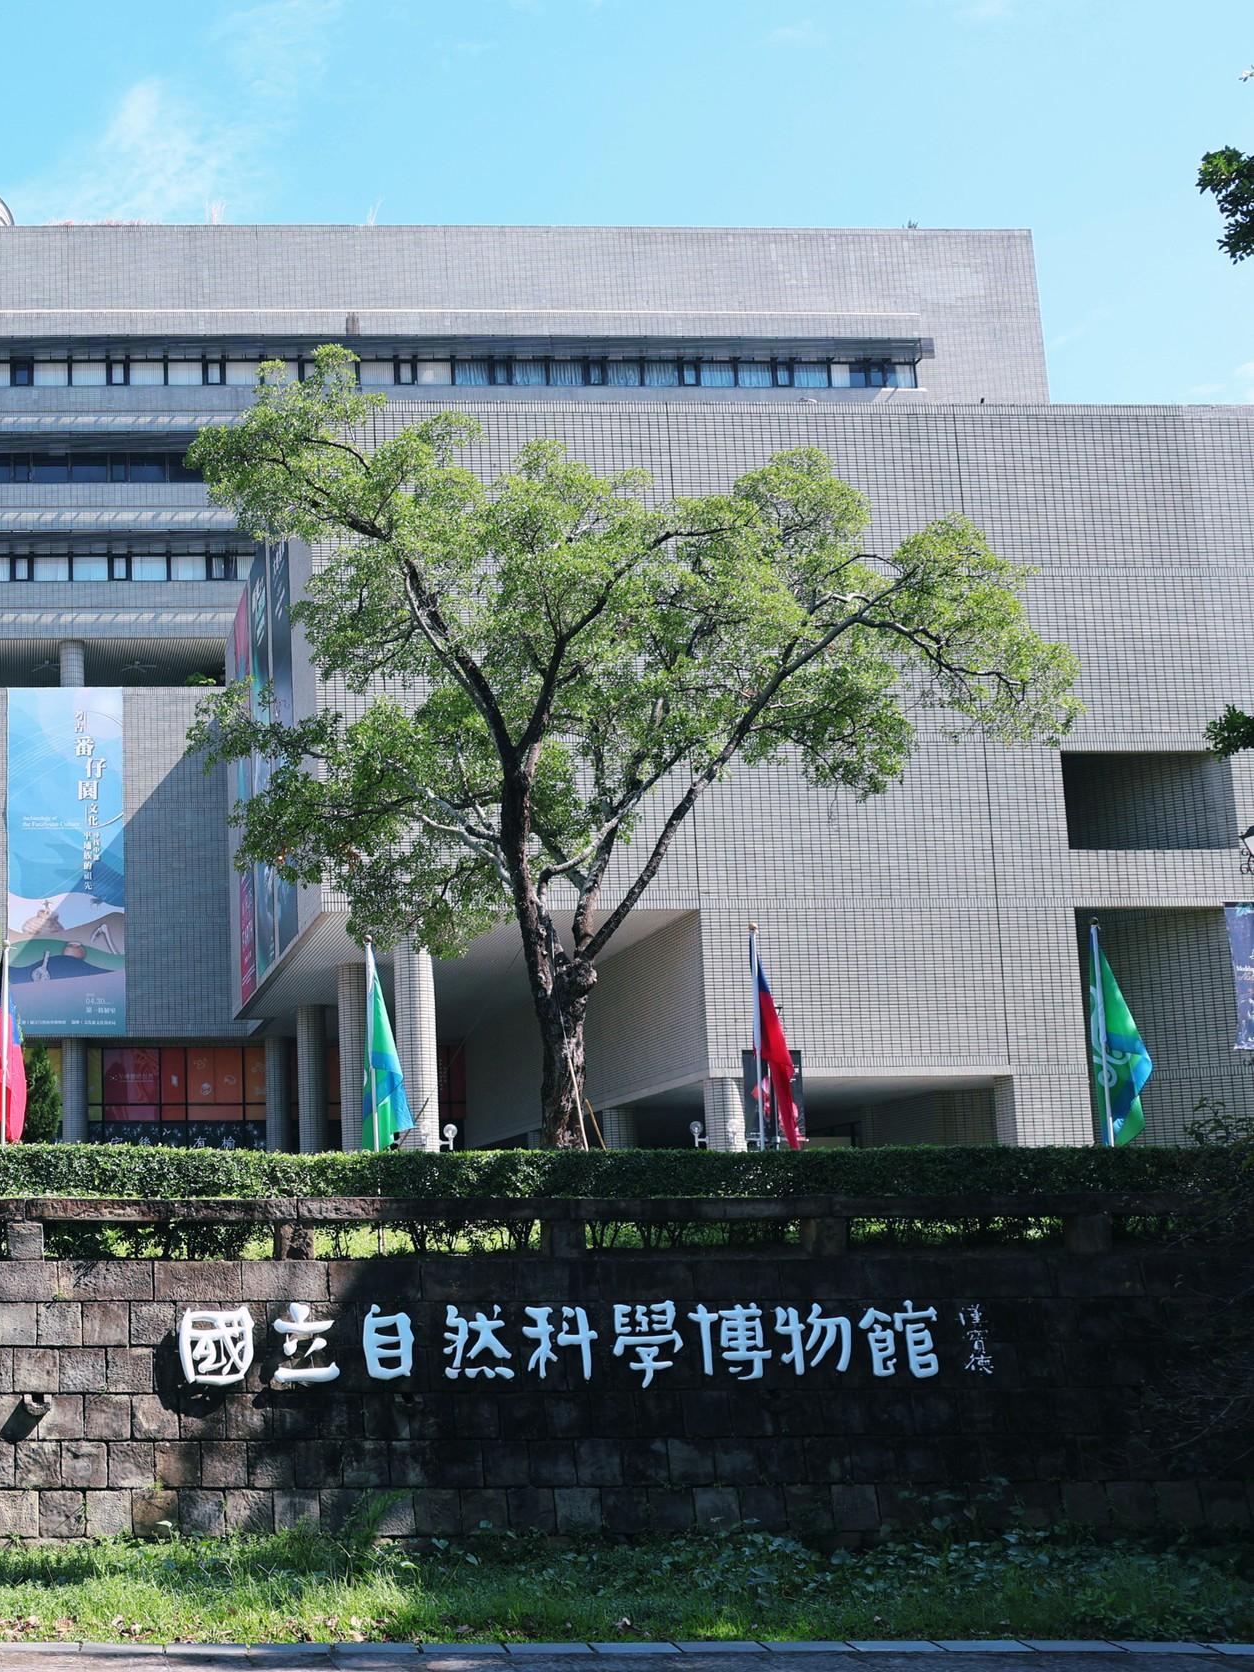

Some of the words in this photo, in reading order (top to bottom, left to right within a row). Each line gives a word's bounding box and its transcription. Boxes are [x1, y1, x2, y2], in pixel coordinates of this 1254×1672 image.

[179, 1301, 941, 1388] 國立自然科學博物館
